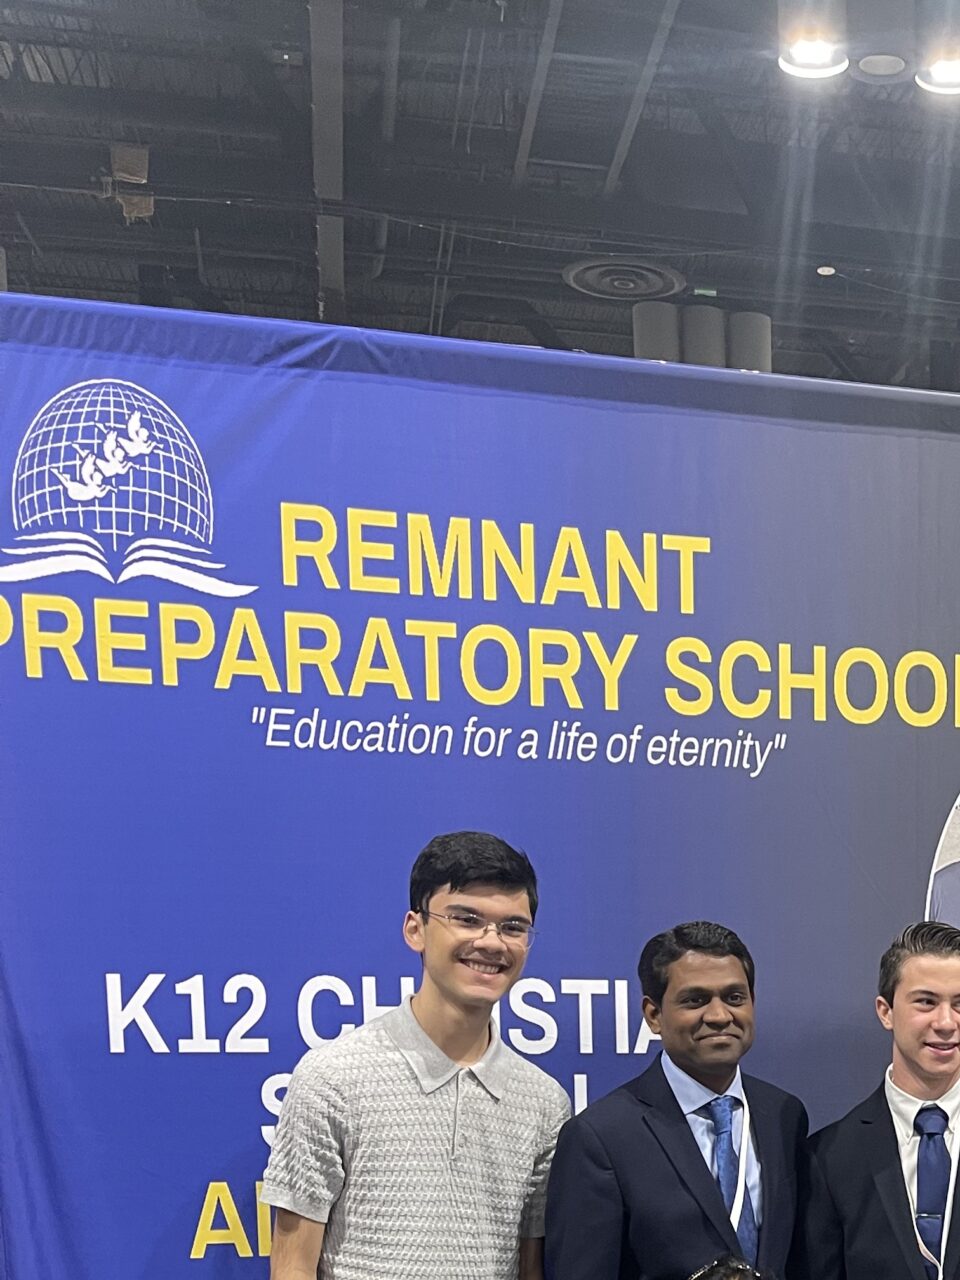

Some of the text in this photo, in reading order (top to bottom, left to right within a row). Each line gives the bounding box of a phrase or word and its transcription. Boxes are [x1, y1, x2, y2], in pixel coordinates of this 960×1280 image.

[280, 502, 711, 614] REMNANT
[0, 593, 638, 711] REPARATORY
[250, 704, 787, 779] "Education for a life of eternity"
[105, 973, 270, 1055] K12
